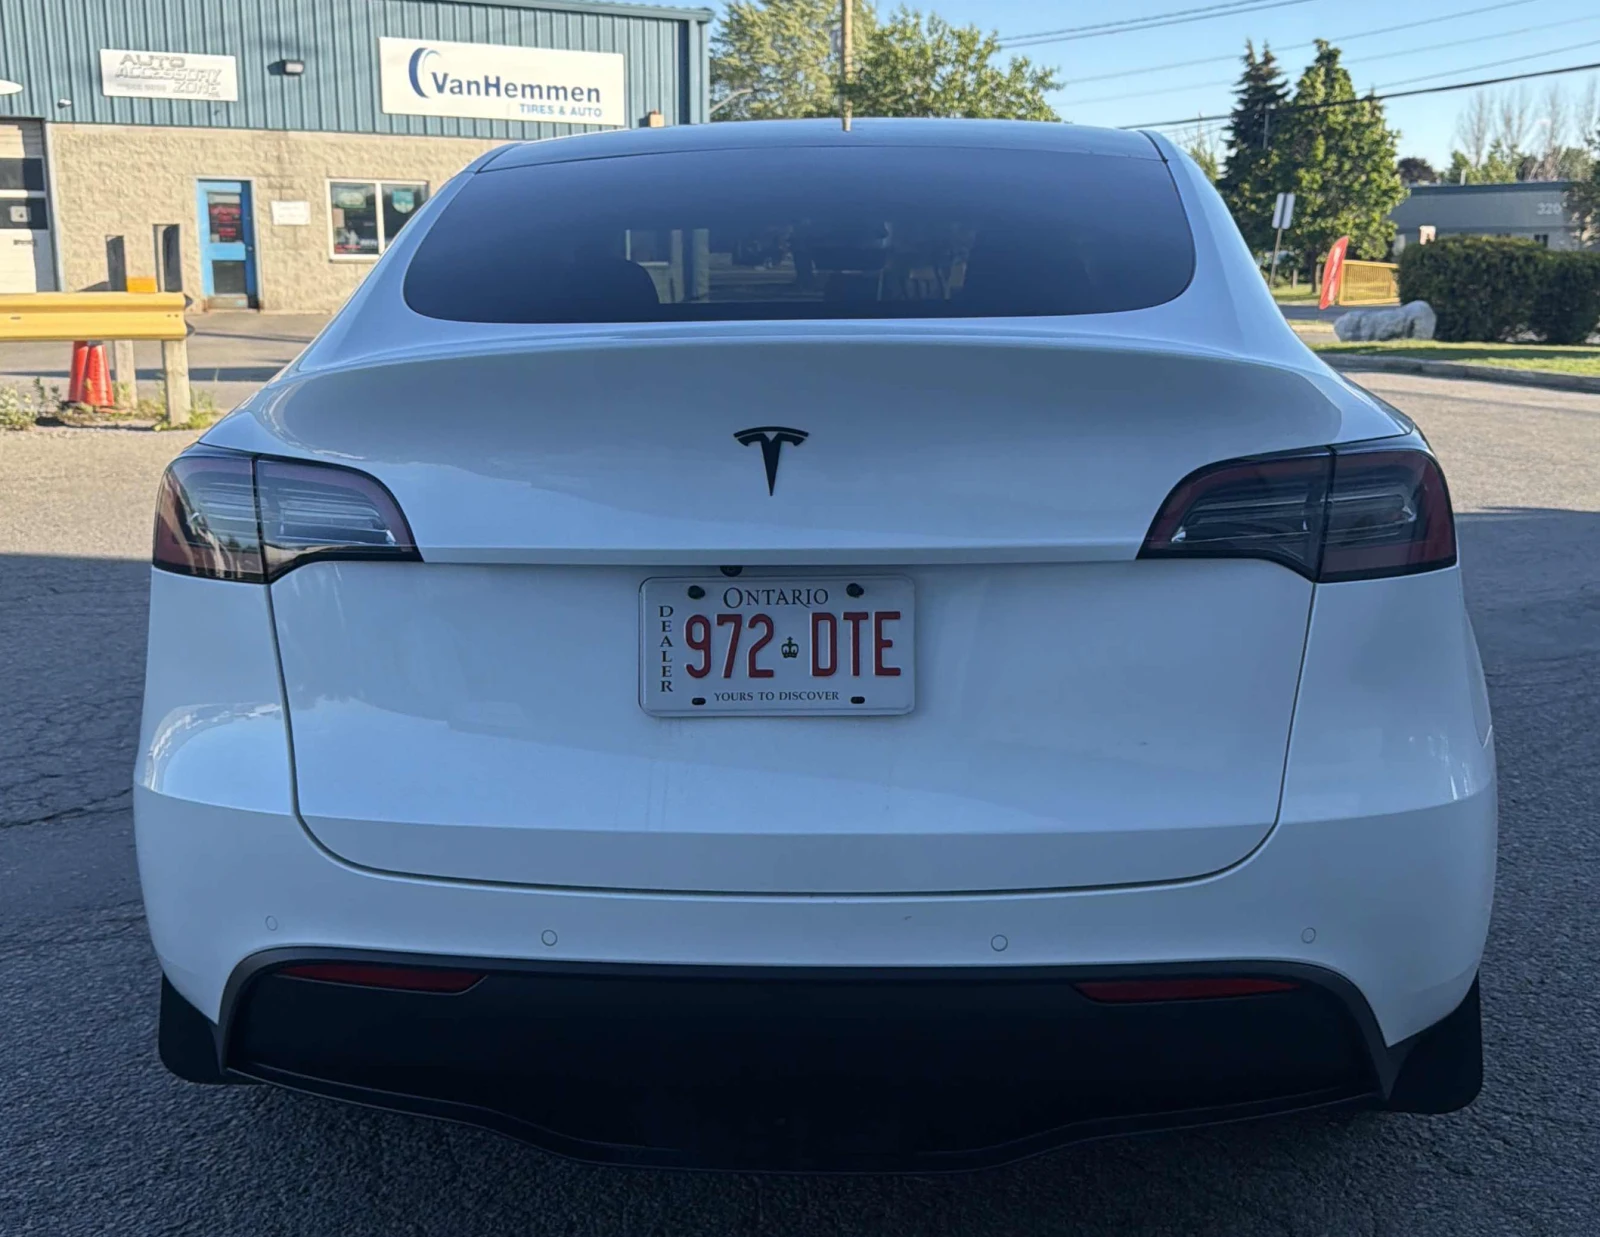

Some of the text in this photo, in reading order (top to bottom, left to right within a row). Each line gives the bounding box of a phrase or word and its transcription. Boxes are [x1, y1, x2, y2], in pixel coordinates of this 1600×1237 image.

[119, 54, 186, 69] AUTO
[431, 72, 601, 103] VanHemmen
[519, 103, 603, 117] TIRES & AUTO
[723, 587, 829, 608] ONTARIO
[658, 605, 674, 692] DEALER
[684, 611, 901, 678] 972 DTE
[714, 690, 839, 702] YOURS TO DISCOVER
